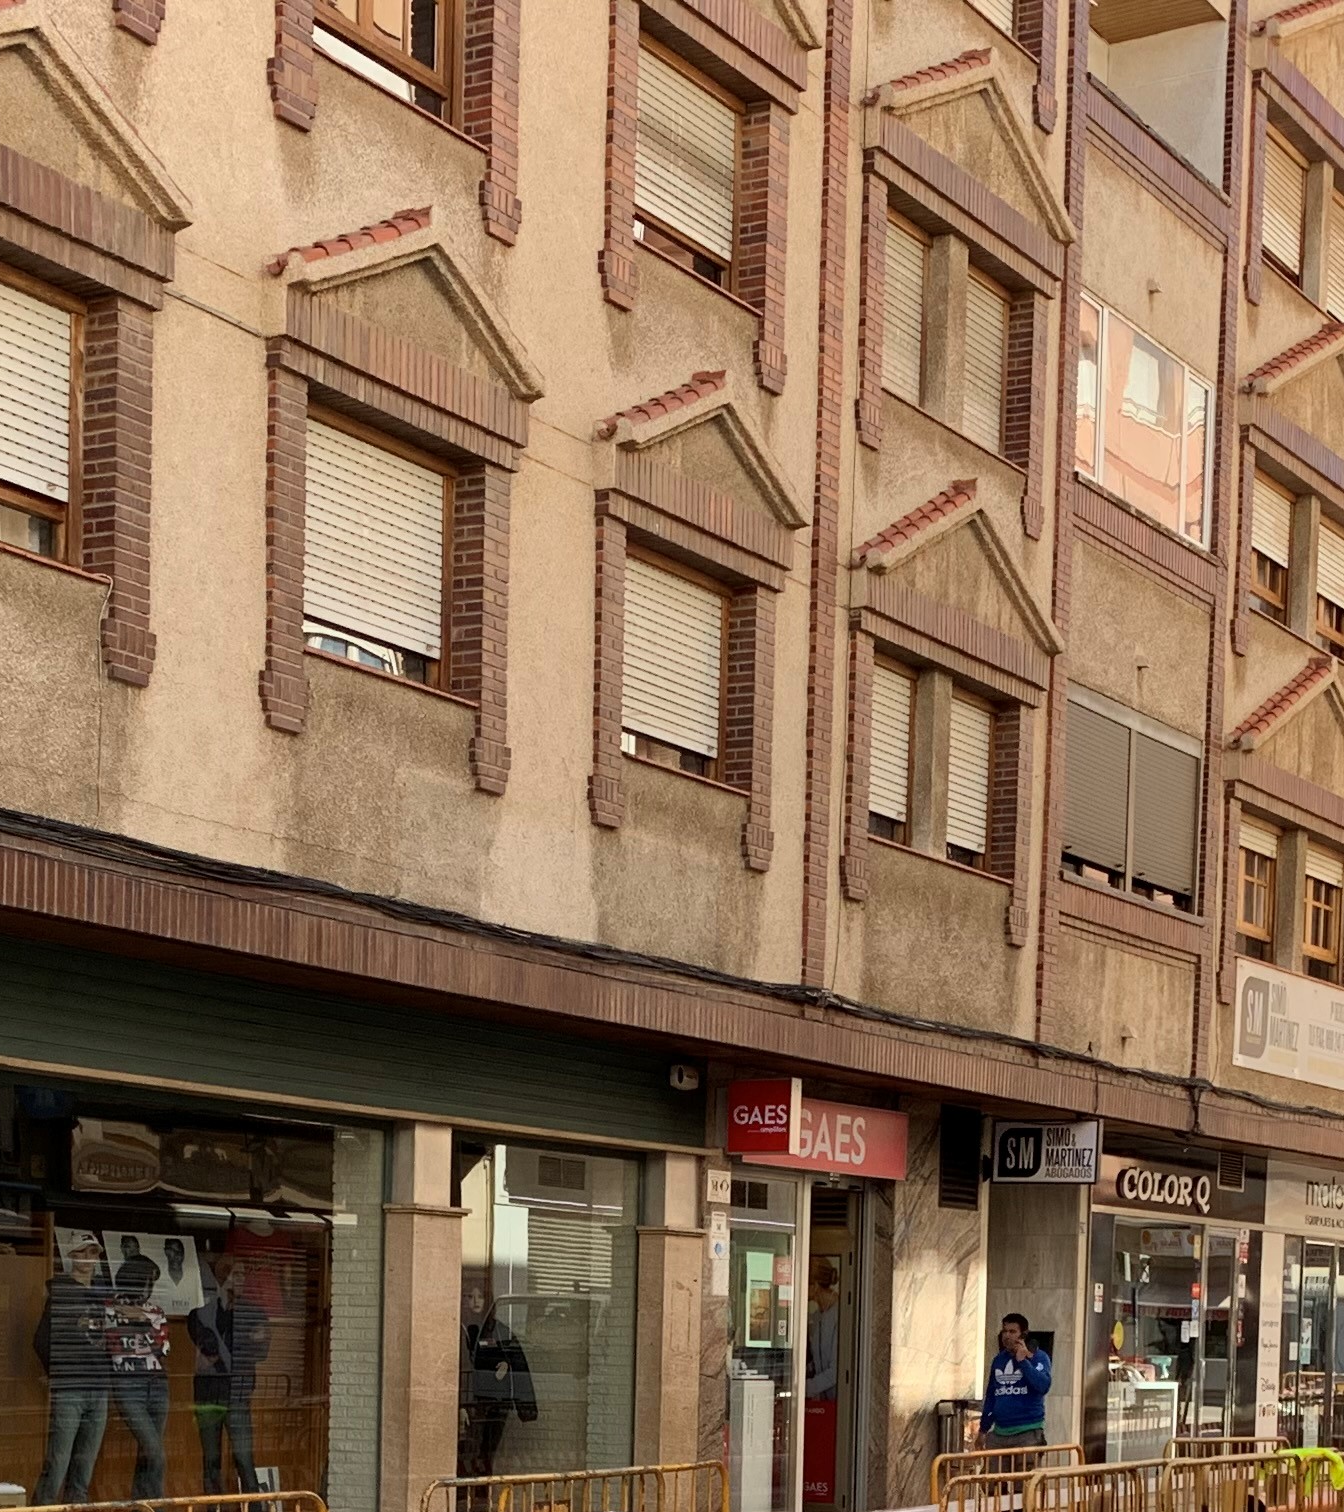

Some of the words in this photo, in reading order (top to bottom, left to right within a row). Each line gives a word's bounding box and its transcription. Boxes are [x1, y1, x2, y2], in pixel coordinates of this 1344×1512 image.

[733, 1104, 788, 1125] GAES
[797, 1108, 866, 1165] GAES
[1046, 1127, 1071, 1147] SIMO
[1045, 1148, 1093, 1167] MARTINEZ
[1045, 1167, 1092, 1178] ABOGADOS
[1121, 1167, 1193, 1207] COLOR
[1196, 1175, 1211, 1214] Q
